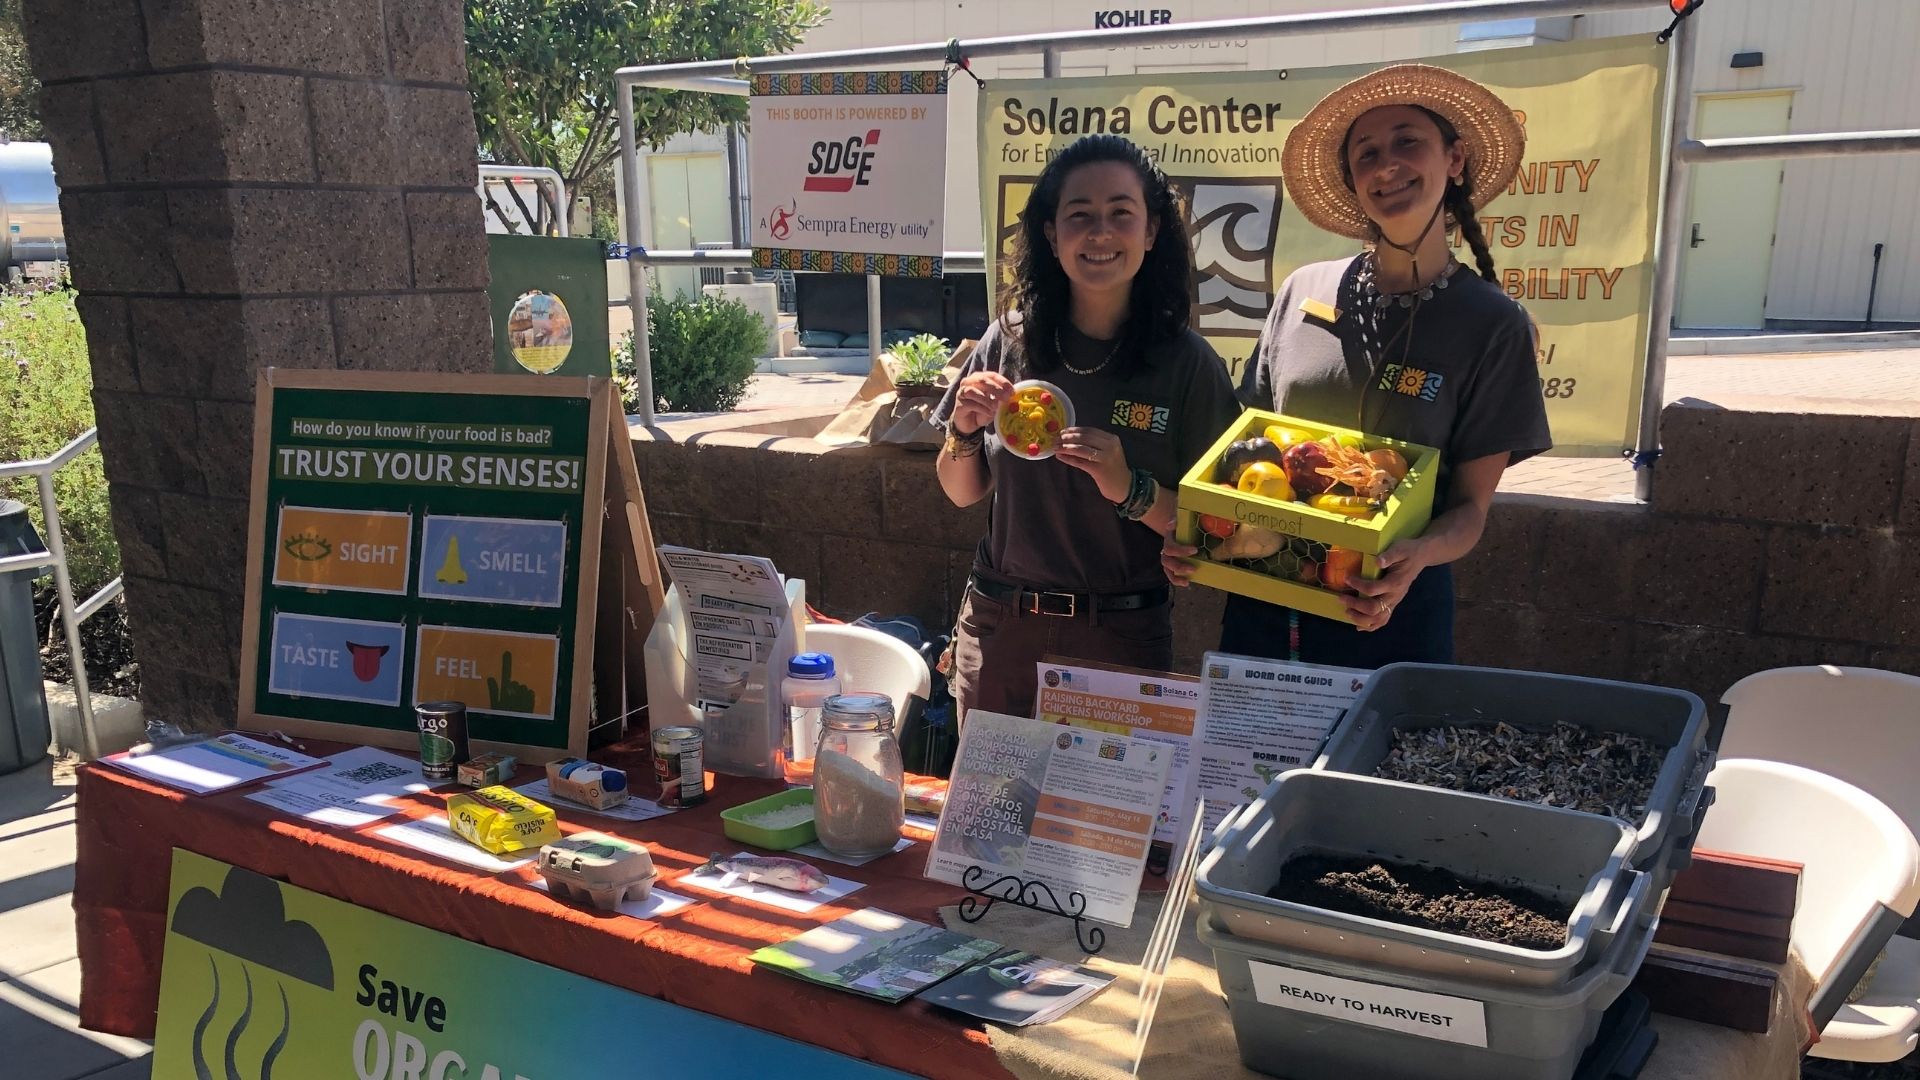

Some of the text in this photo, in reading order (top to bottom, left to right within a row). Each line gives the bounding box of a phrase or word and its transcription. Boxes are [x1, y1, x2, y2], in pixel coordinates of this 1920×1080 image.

[1095, 9, 1172, 29] KOHLER
[767, 107, 927, 121] THIS BOOTH IS POWERED BY
[1003, 95, 1281, 136] Solana Center
[1001, 143, 1029, 163] for
[1172, 143, 1279, 163] Innovation
[760, 219, 767, 229] A
[797, 215, 846, 236] Sempra
[850, 216, 896, 239] Energy
[1537, 214, 1579, 247] IN
[293, 420, 551, 444] How do you know if your food is bad?
[279, 449, 579, 489] TRUST YOUR SENSES!
[1234, 501, 1303, 533] Compost
[340, 542, 398, 565] SIGHT
[479, 551, 547, 575] SMELL
[281, 644, 339, 669] TASTE
[435, 656, 482, 680] FEEL
[1245, 669, 1333, 687] WORM CARE GUIDE
[1044, 691, 1140, 714] RAISING BACKYARD
[1043, 702, 1091, 717] CHICKENS
[1094, 709, 1152, 727] WORKSHOP
[971, 728, 1027, 745] BACKYARD
[966, 750, 1028, 769] BASICS FREE
[968, 738, 1038, 759] COMPOSTING
[1253, 752, 1278, 760] WORM
[964, 759, 1025, 779] WORKSHOP
[958, 780, 1009, 798] CLASE DE
[954, 790, 1023, 812] CONCEPTOS
[948, 811, 1024, 836] COMPOSTAJE
[1003, 812, 1023, 825] DEL
[945, 822, 993, 841] EN CASA
[356, 964, 446, 1033] Save
[1280, 984, 1453, 1027] READY TO HARVEST
